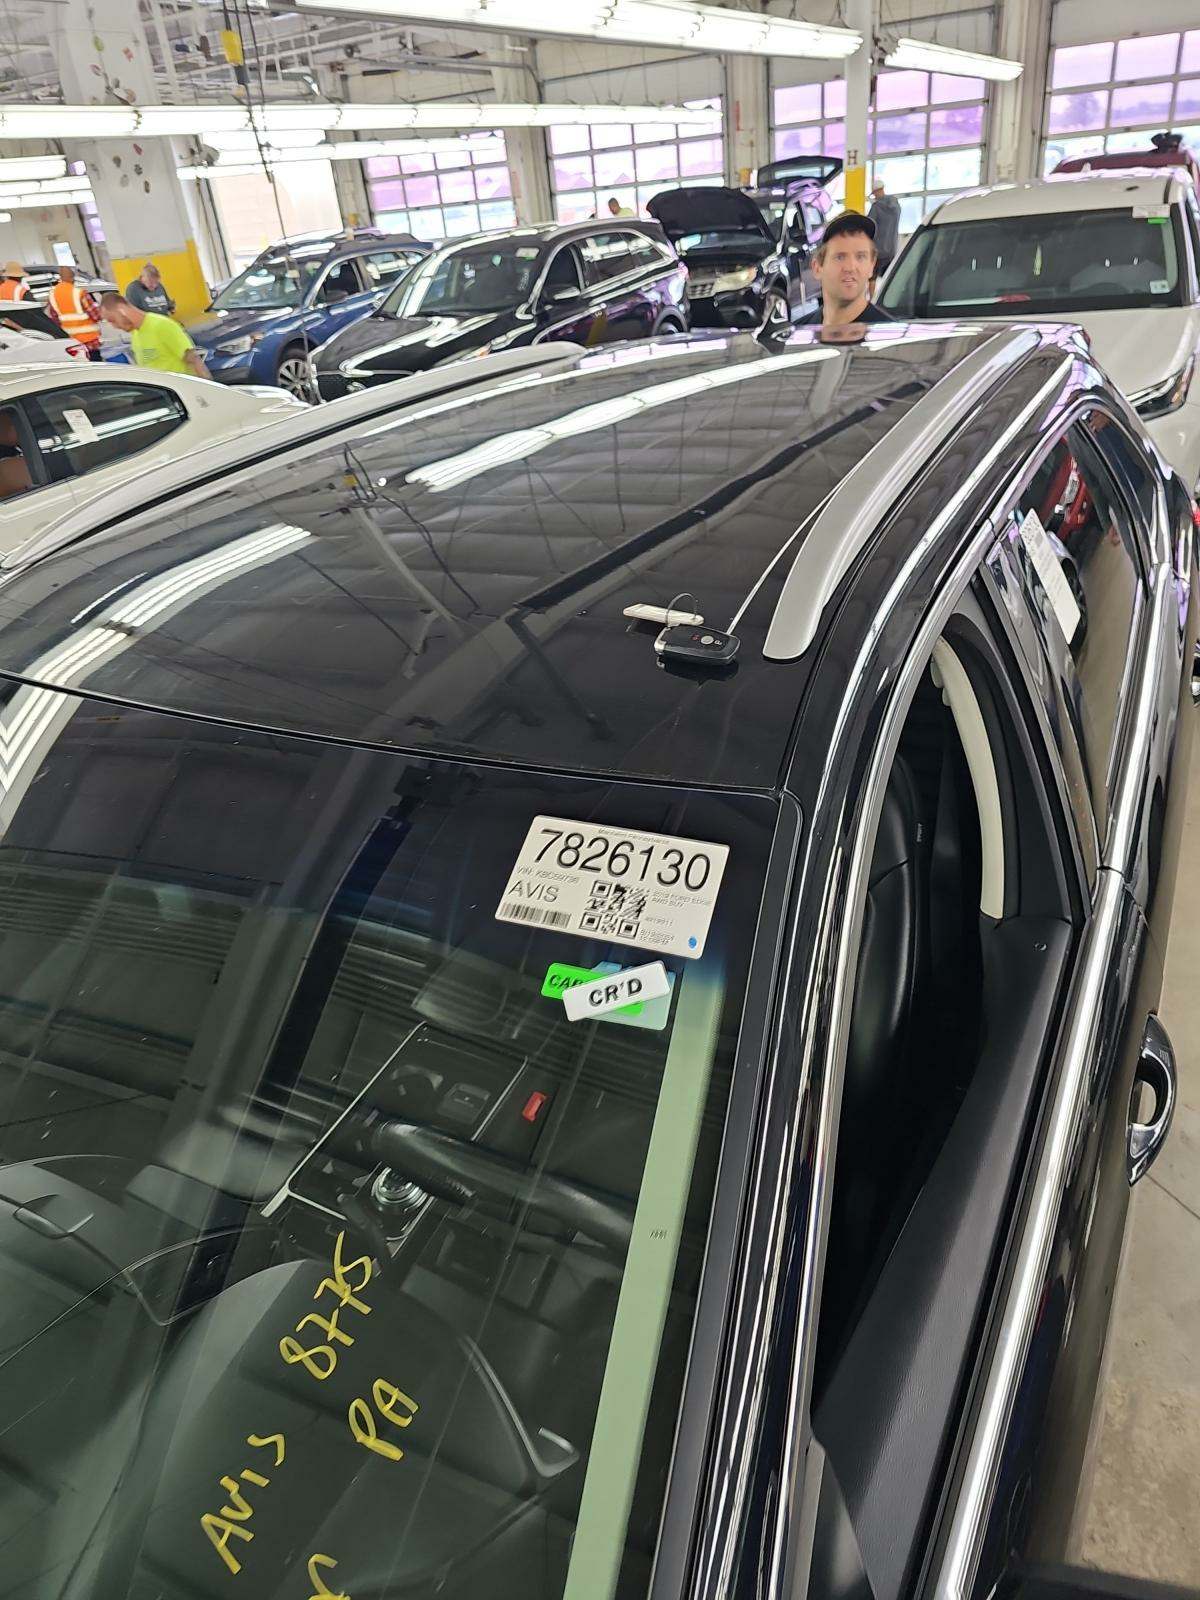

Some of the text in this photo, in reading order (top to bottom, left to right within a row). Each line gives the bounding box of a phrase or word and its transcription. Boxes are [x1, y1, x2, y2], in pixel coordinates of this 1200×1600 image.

[847, 150, 858, 165] H
[535, 828, 711, 891] 7826130
[508, 880, 559, 902] AVIS
[589, 978, 643, 1006] CR'D
